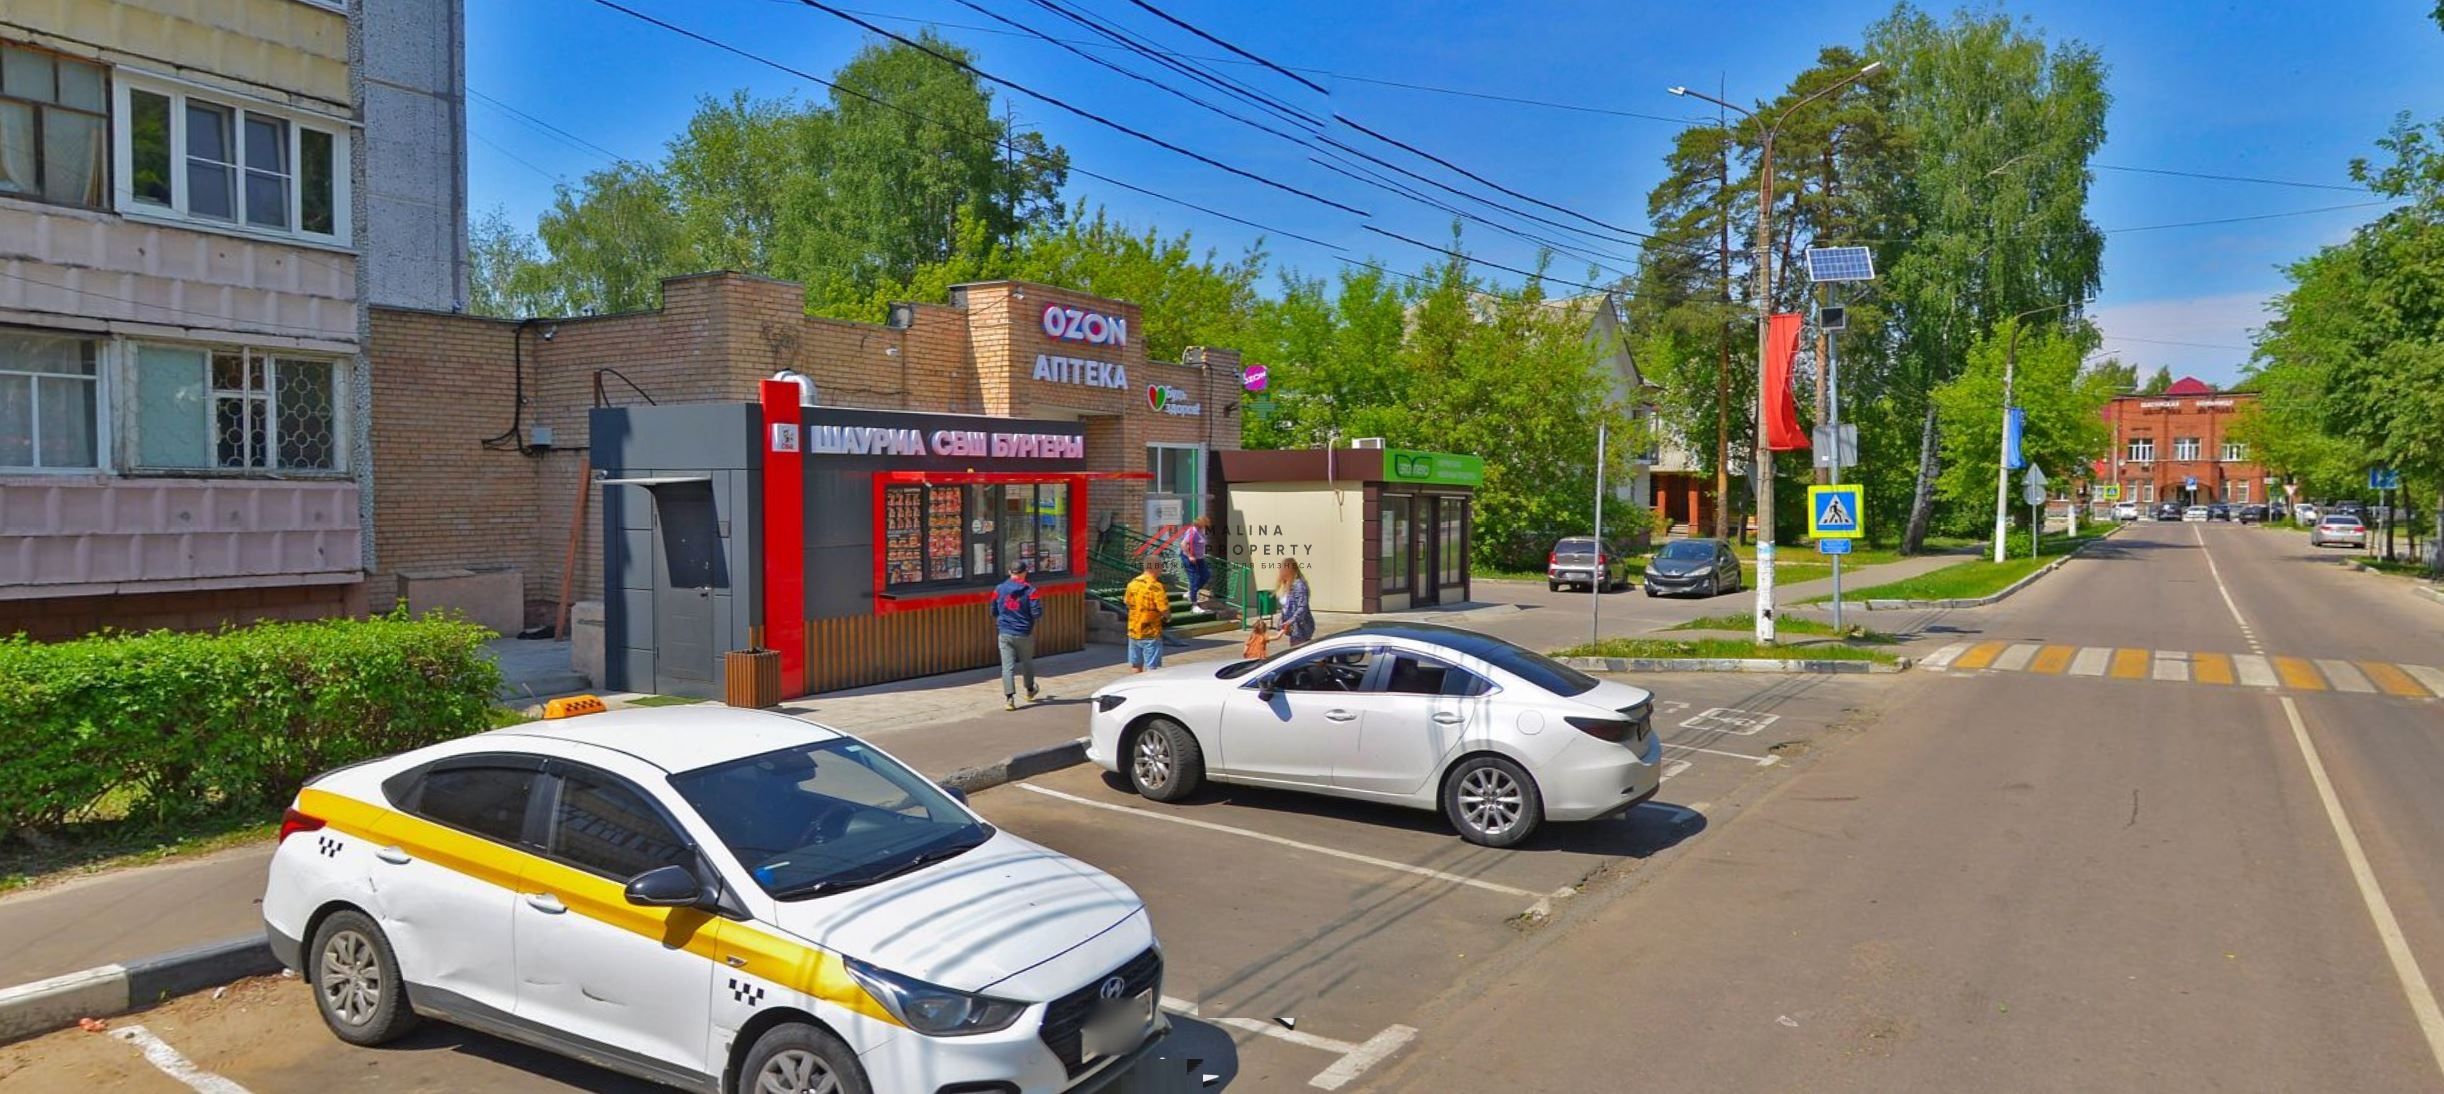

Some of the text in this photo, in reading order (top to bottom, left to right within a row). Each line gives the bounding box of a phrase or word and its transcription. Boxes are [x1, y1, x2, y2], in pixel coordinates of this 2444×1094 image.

[1043, 305, 1127, 345] OZON
[1032, 354, 1129, 390] АПТЕКА
[810, 425, 927, 456] ШАУРМА
[991, 432, 1084, 458] БУРГЕРЫ
